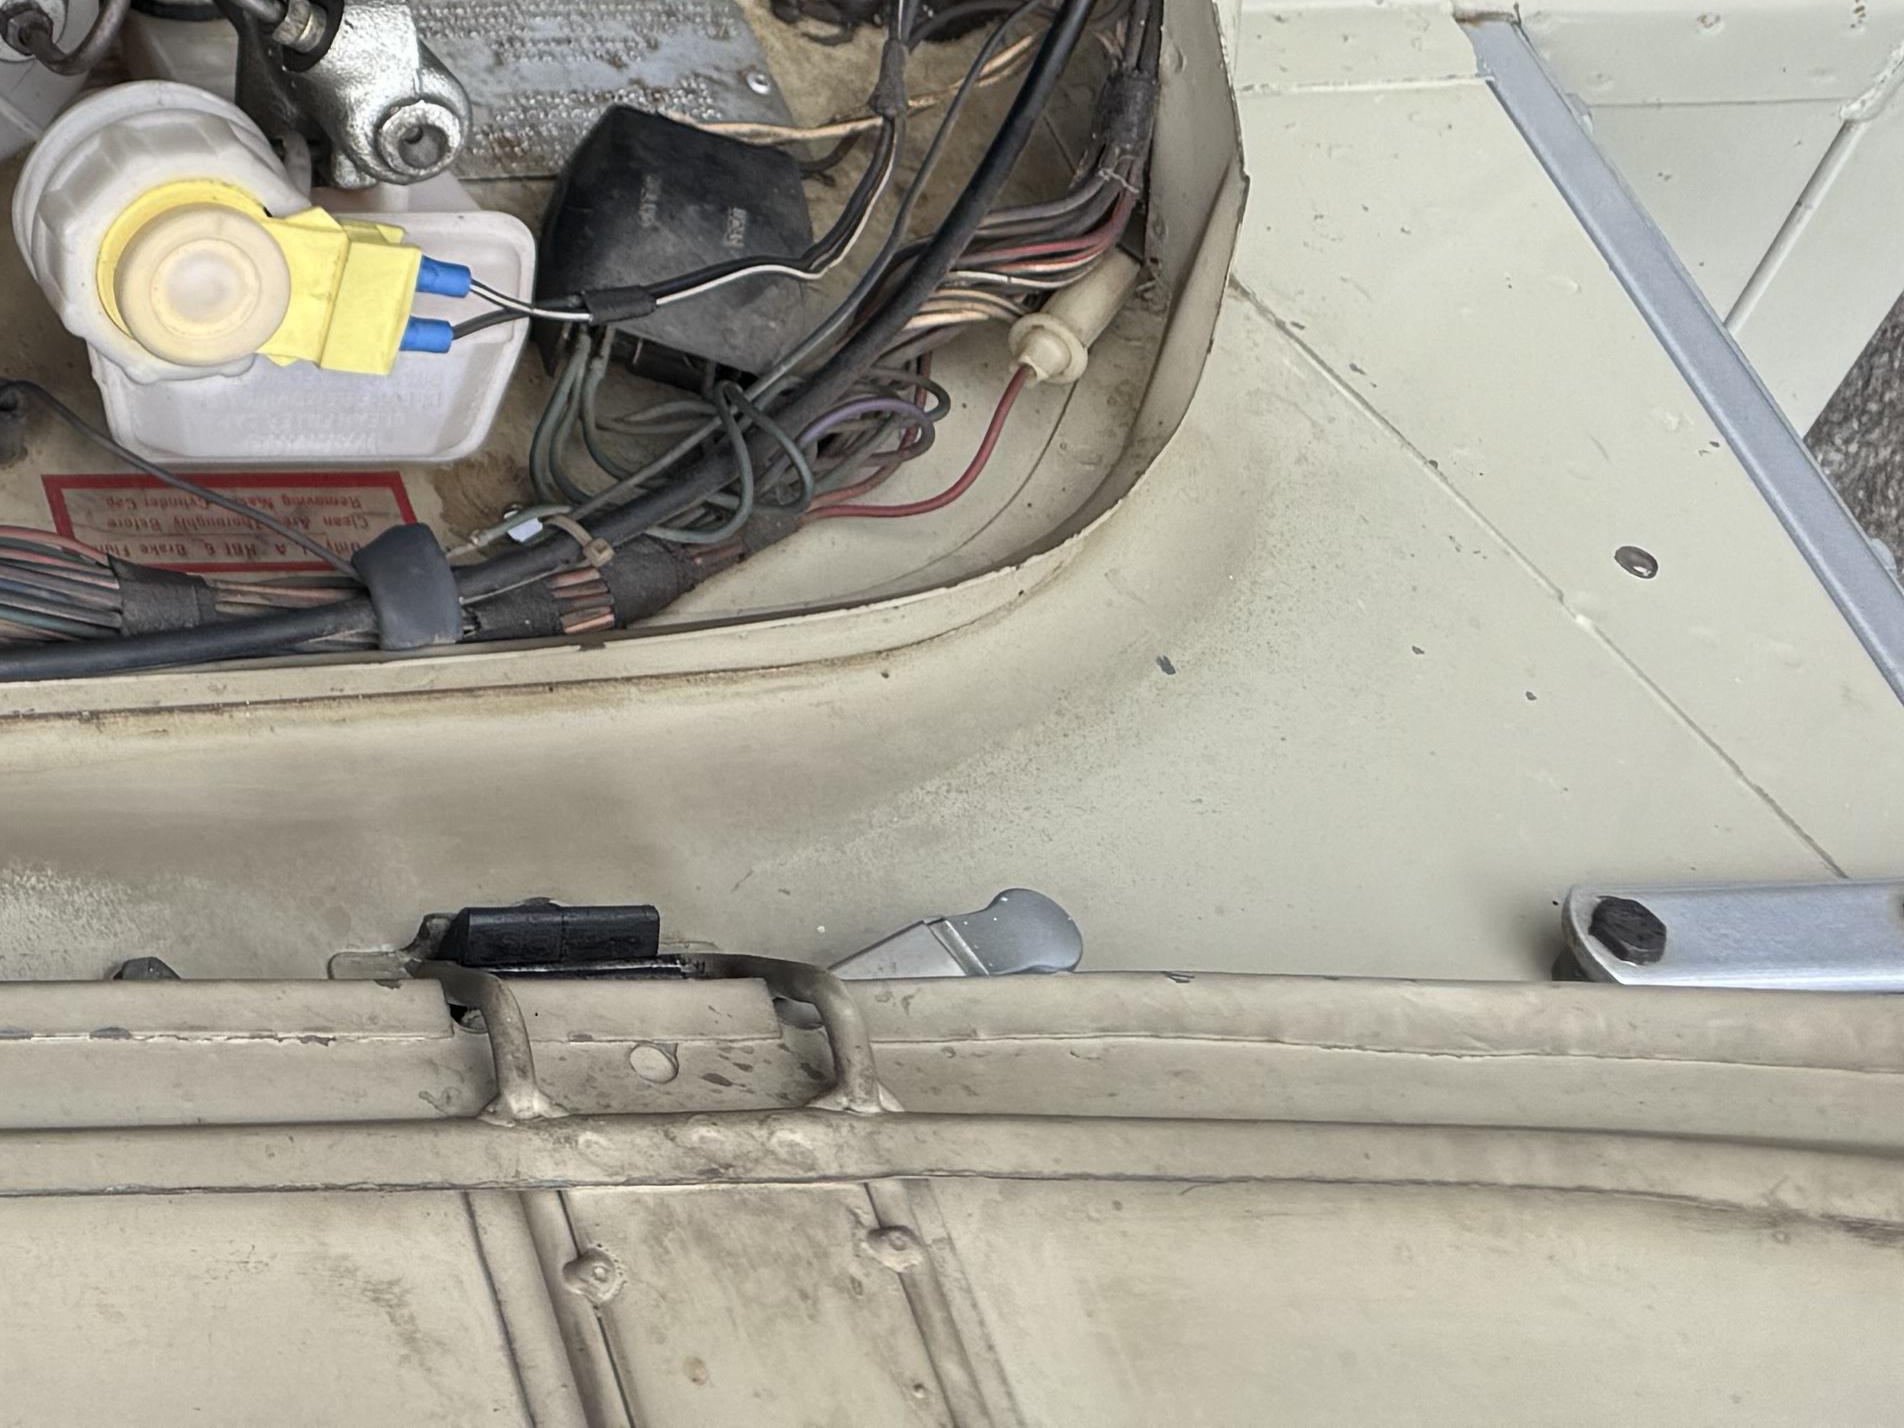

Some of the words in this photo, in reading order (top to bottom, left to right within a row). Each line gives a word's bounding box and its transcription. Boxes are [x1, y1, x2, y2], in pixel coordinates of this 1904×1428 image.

[104, 495, 137, 509] Cap
[144, 494, 210, 510] Cylinder
[280, 494, 362, 510] Removing
[106, 517, 161, 531] Before
[282, 516, 312, 530] Are
[322, 515, 369, 531] Clean
[139, 543, 186, 557] Brake
